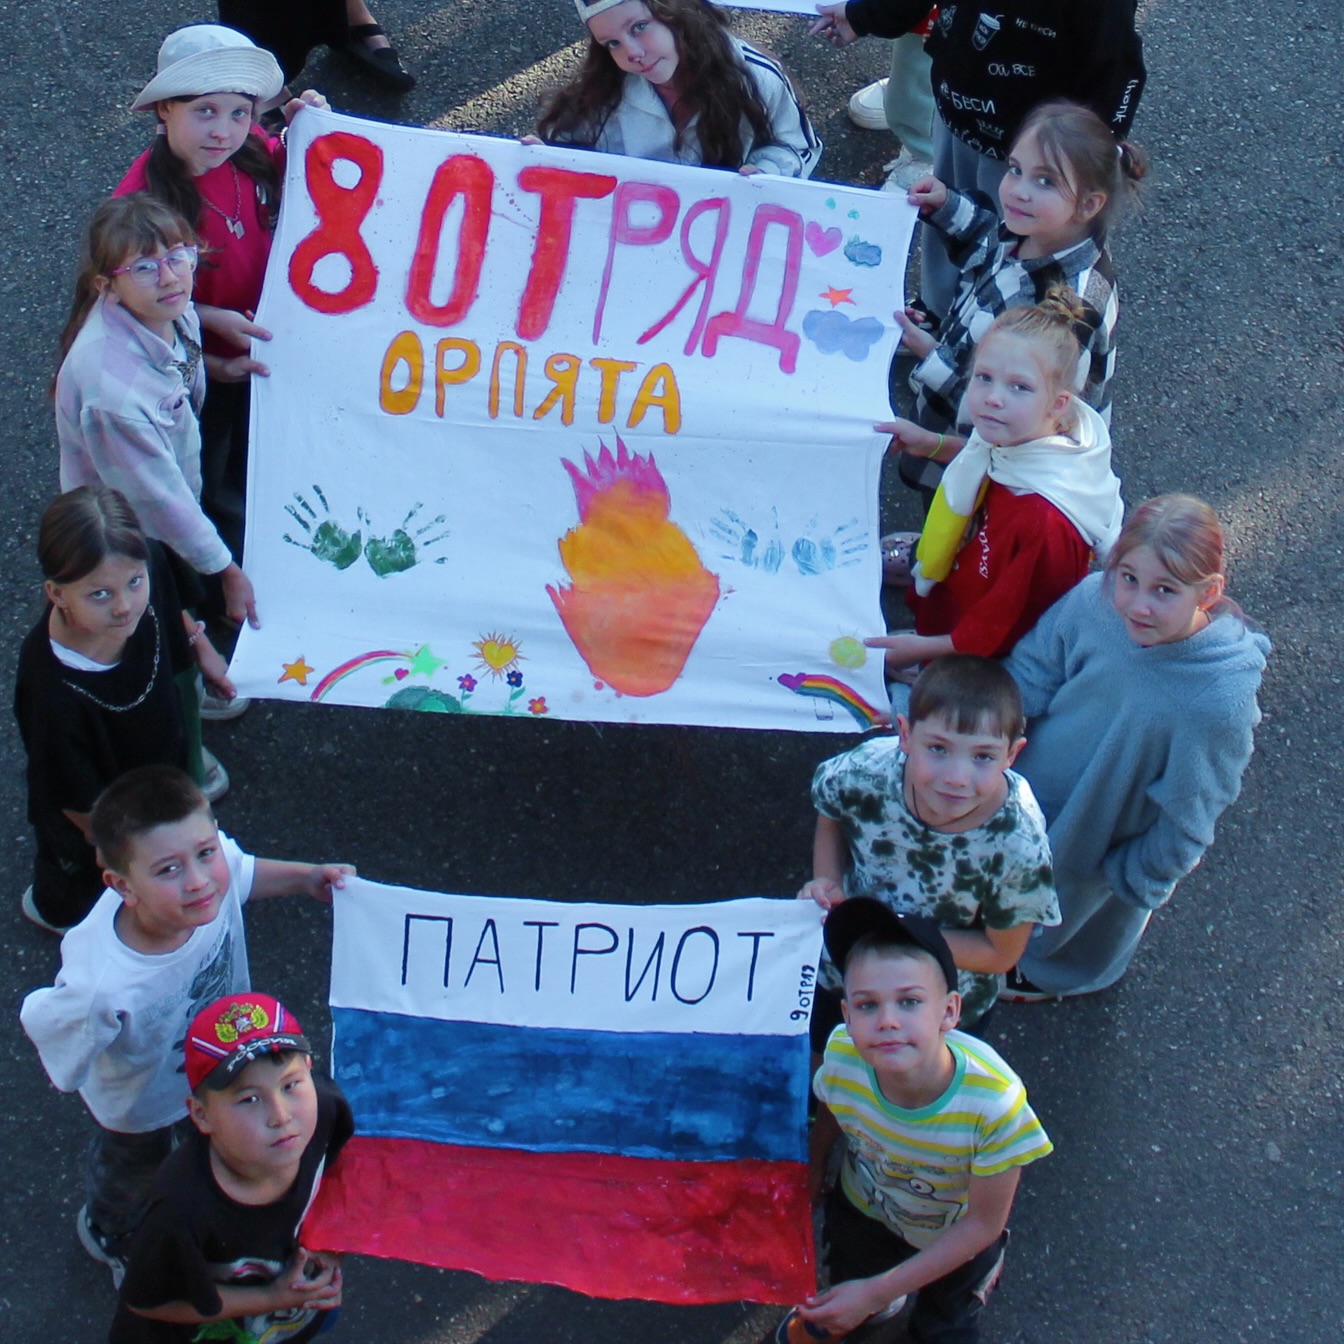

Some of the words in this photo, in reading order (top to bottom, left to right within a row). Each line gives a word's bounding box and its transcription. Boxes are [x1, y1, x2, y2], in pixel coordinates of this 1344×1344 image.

[951, 90, 996, 115] БЕСИ
[288, 131, 384, 315] 8
[404, 154, 804, 374] ОТРЯД
[401, 913, 775, 1005] ПАТРИОТ
